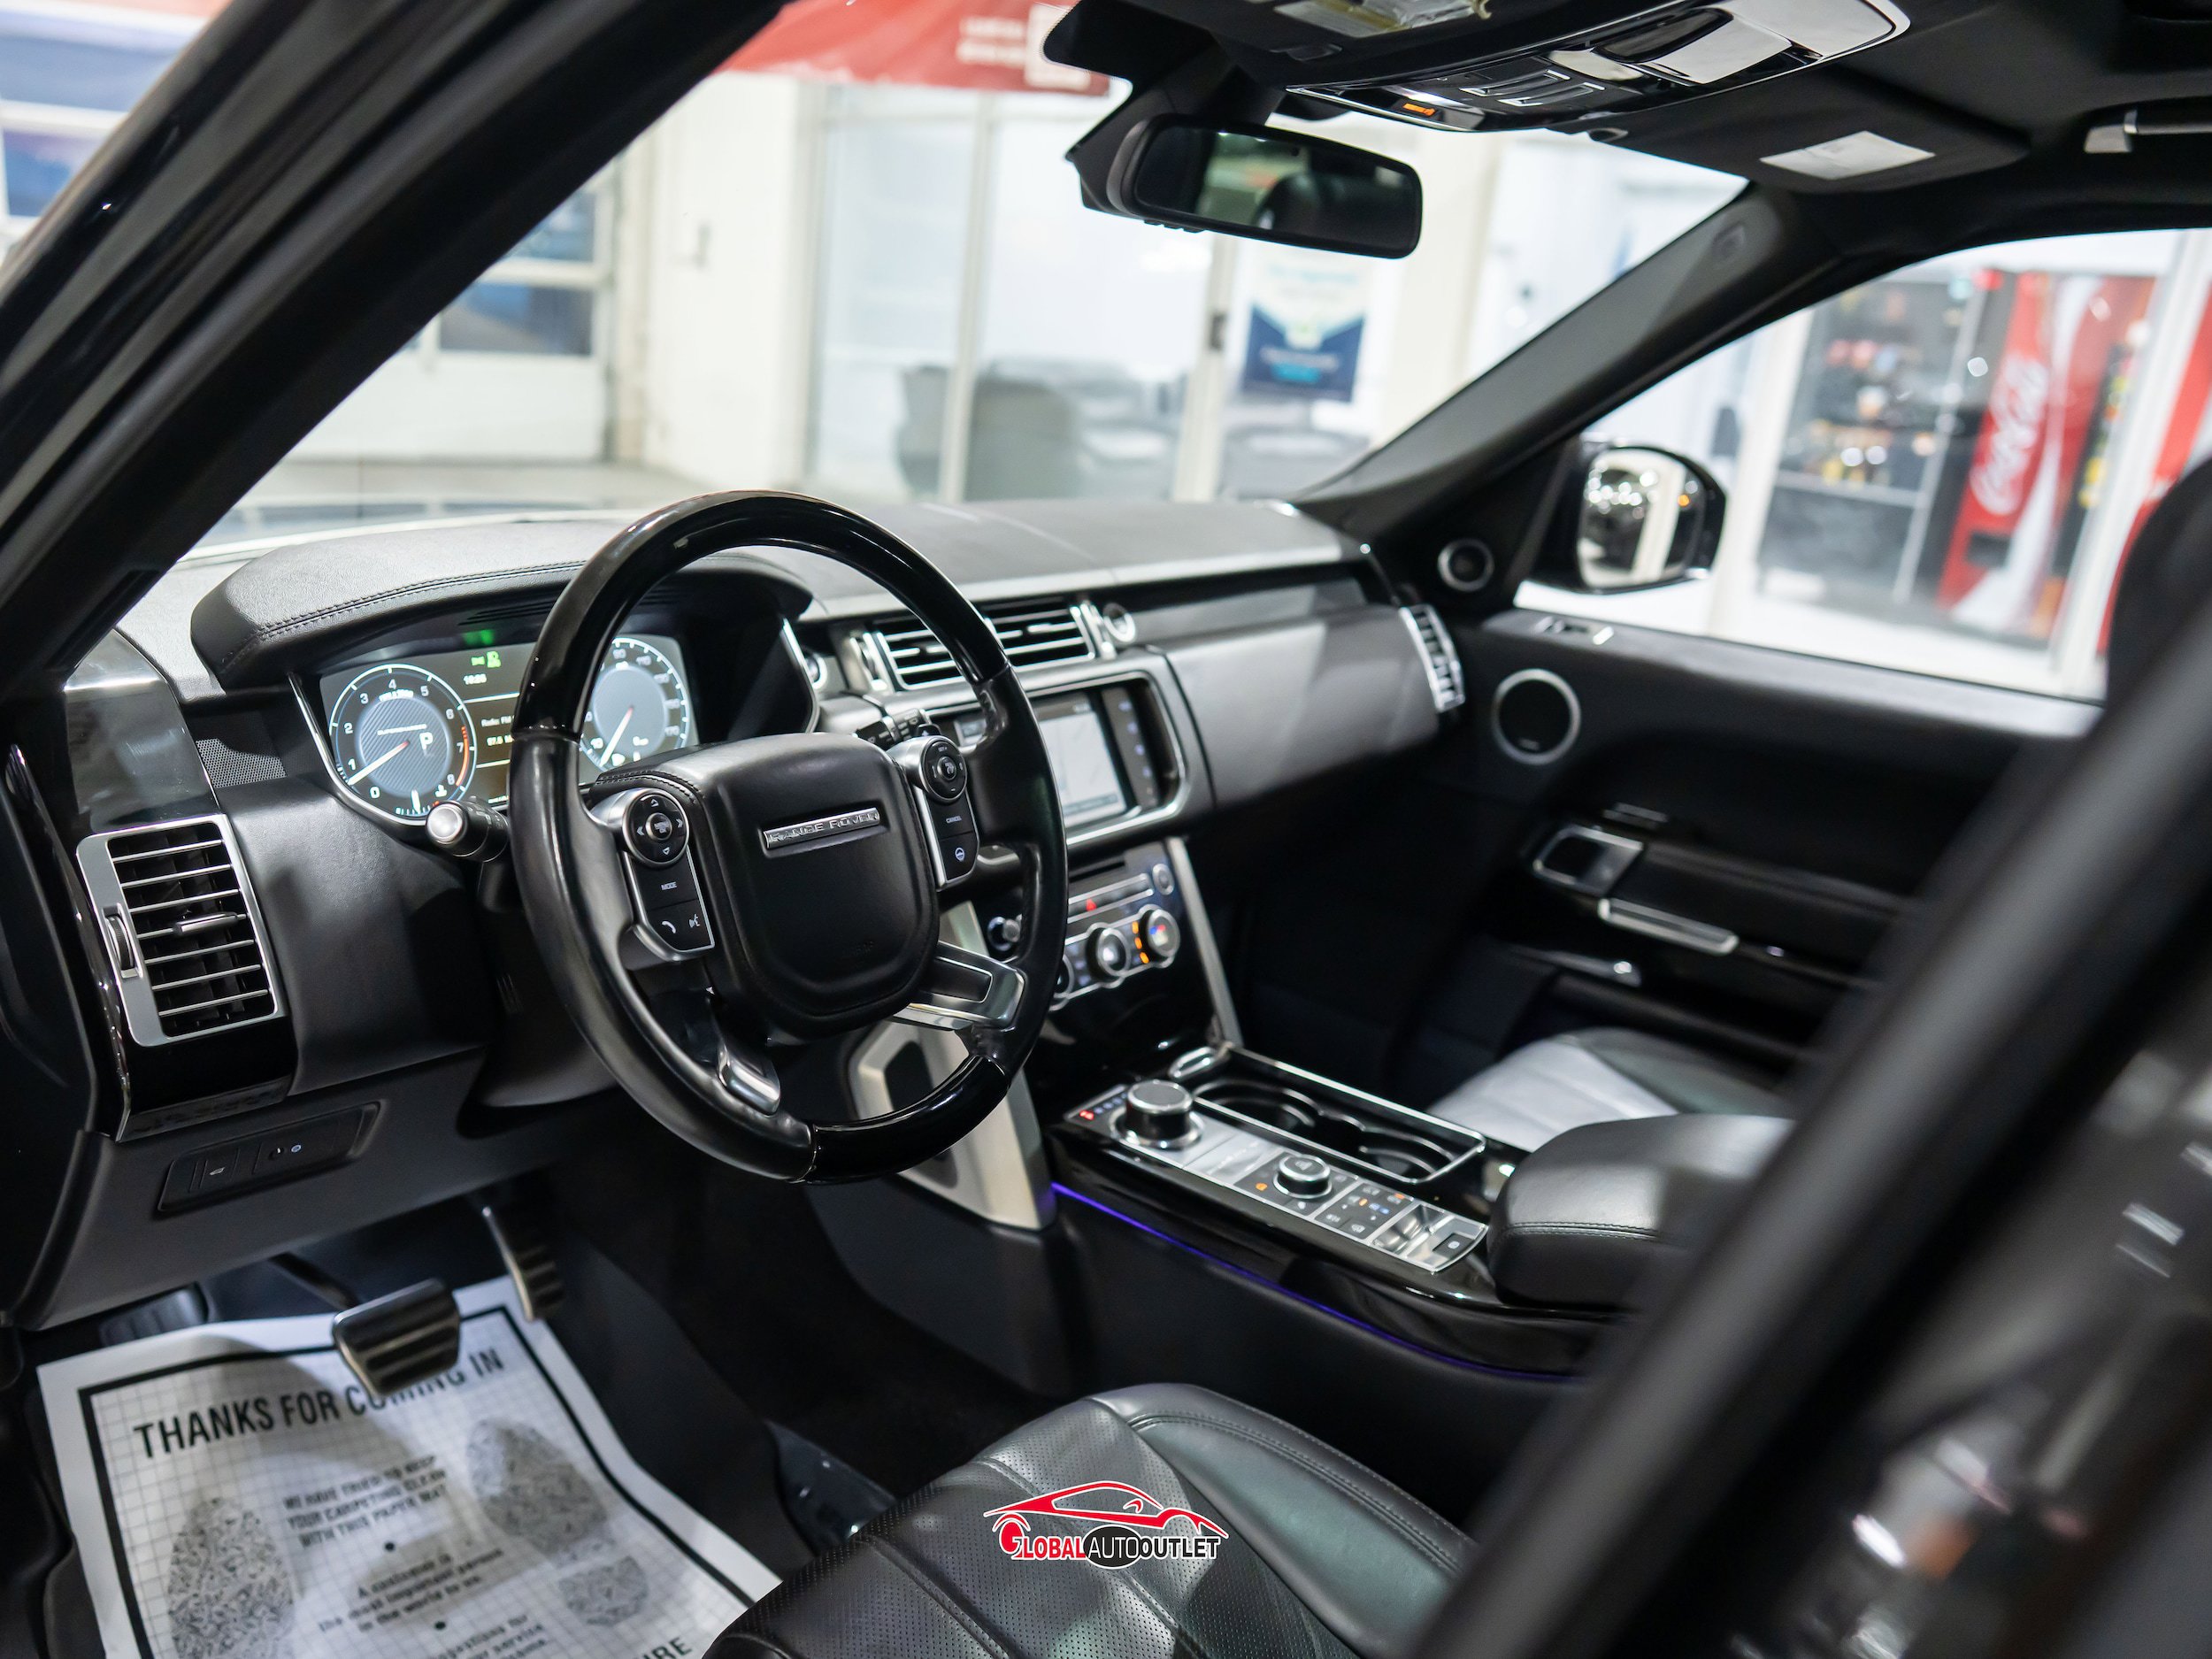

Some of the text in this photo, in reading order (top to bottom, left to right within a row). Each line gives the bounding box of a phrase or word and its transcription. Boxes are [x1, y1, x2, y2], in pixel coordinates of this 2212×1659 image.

[388, 679, 397, 689] 4
[420, 685, 429, 697] 5
[359, 693, 369, 704] 3
[445, 708, 455, 720] 6
[343, 722, 353, 734] 2
[419, 732, 434, 751] P
[457, 741, 465, 753] 7
[348, 758, 357, 771] 1
[446, 773, 456, 786] 8
[370, 786, 380, 799] 0
[945, 815, 963, 824] CANCEL
[769, 811, 879, 842] RANGE ROVER
[661, 881, 678, 891] MODE
[134, 1397, 275, 1458] THANKS
[280, 1388, 340, 1427] FOR
[468, 1348, 504, 1378] IN
[286, 1510, 322, 1530] YOUR
[324, 1486, 401, 1521] CARPETING
[298, 1529, 335, 1548] WITH
[337, 1516, 370, 1535] THIS
[386, 1569, 455, 1603] important
